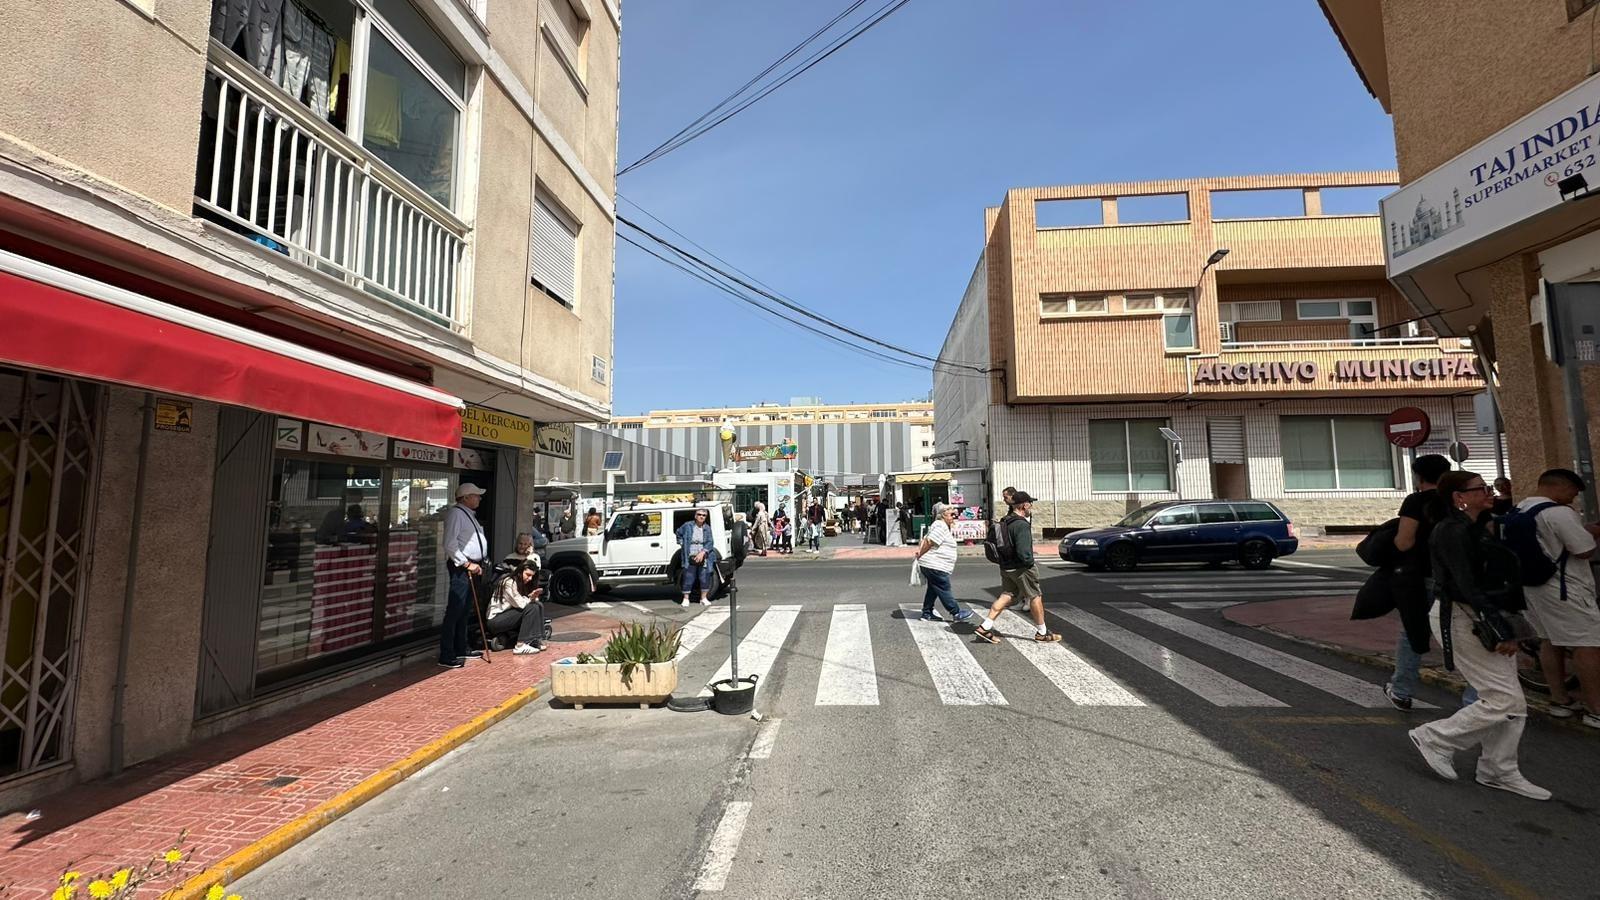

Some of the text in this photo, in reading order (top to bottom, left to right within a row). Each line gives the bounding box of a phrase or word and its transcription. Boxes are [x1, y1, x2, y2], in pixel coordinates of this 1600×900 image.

[1464, 135, 1592, 208] SUPERMARKET
[1470, 147, 1516, 187] TAJ
[1564, 154, 1596, 177] 632
[1195, 362, 1319, 385] ARCHIVO
[458, 408, 531, 433] DEL MERCADO
[549, 437, 572, 456] TOÑI
